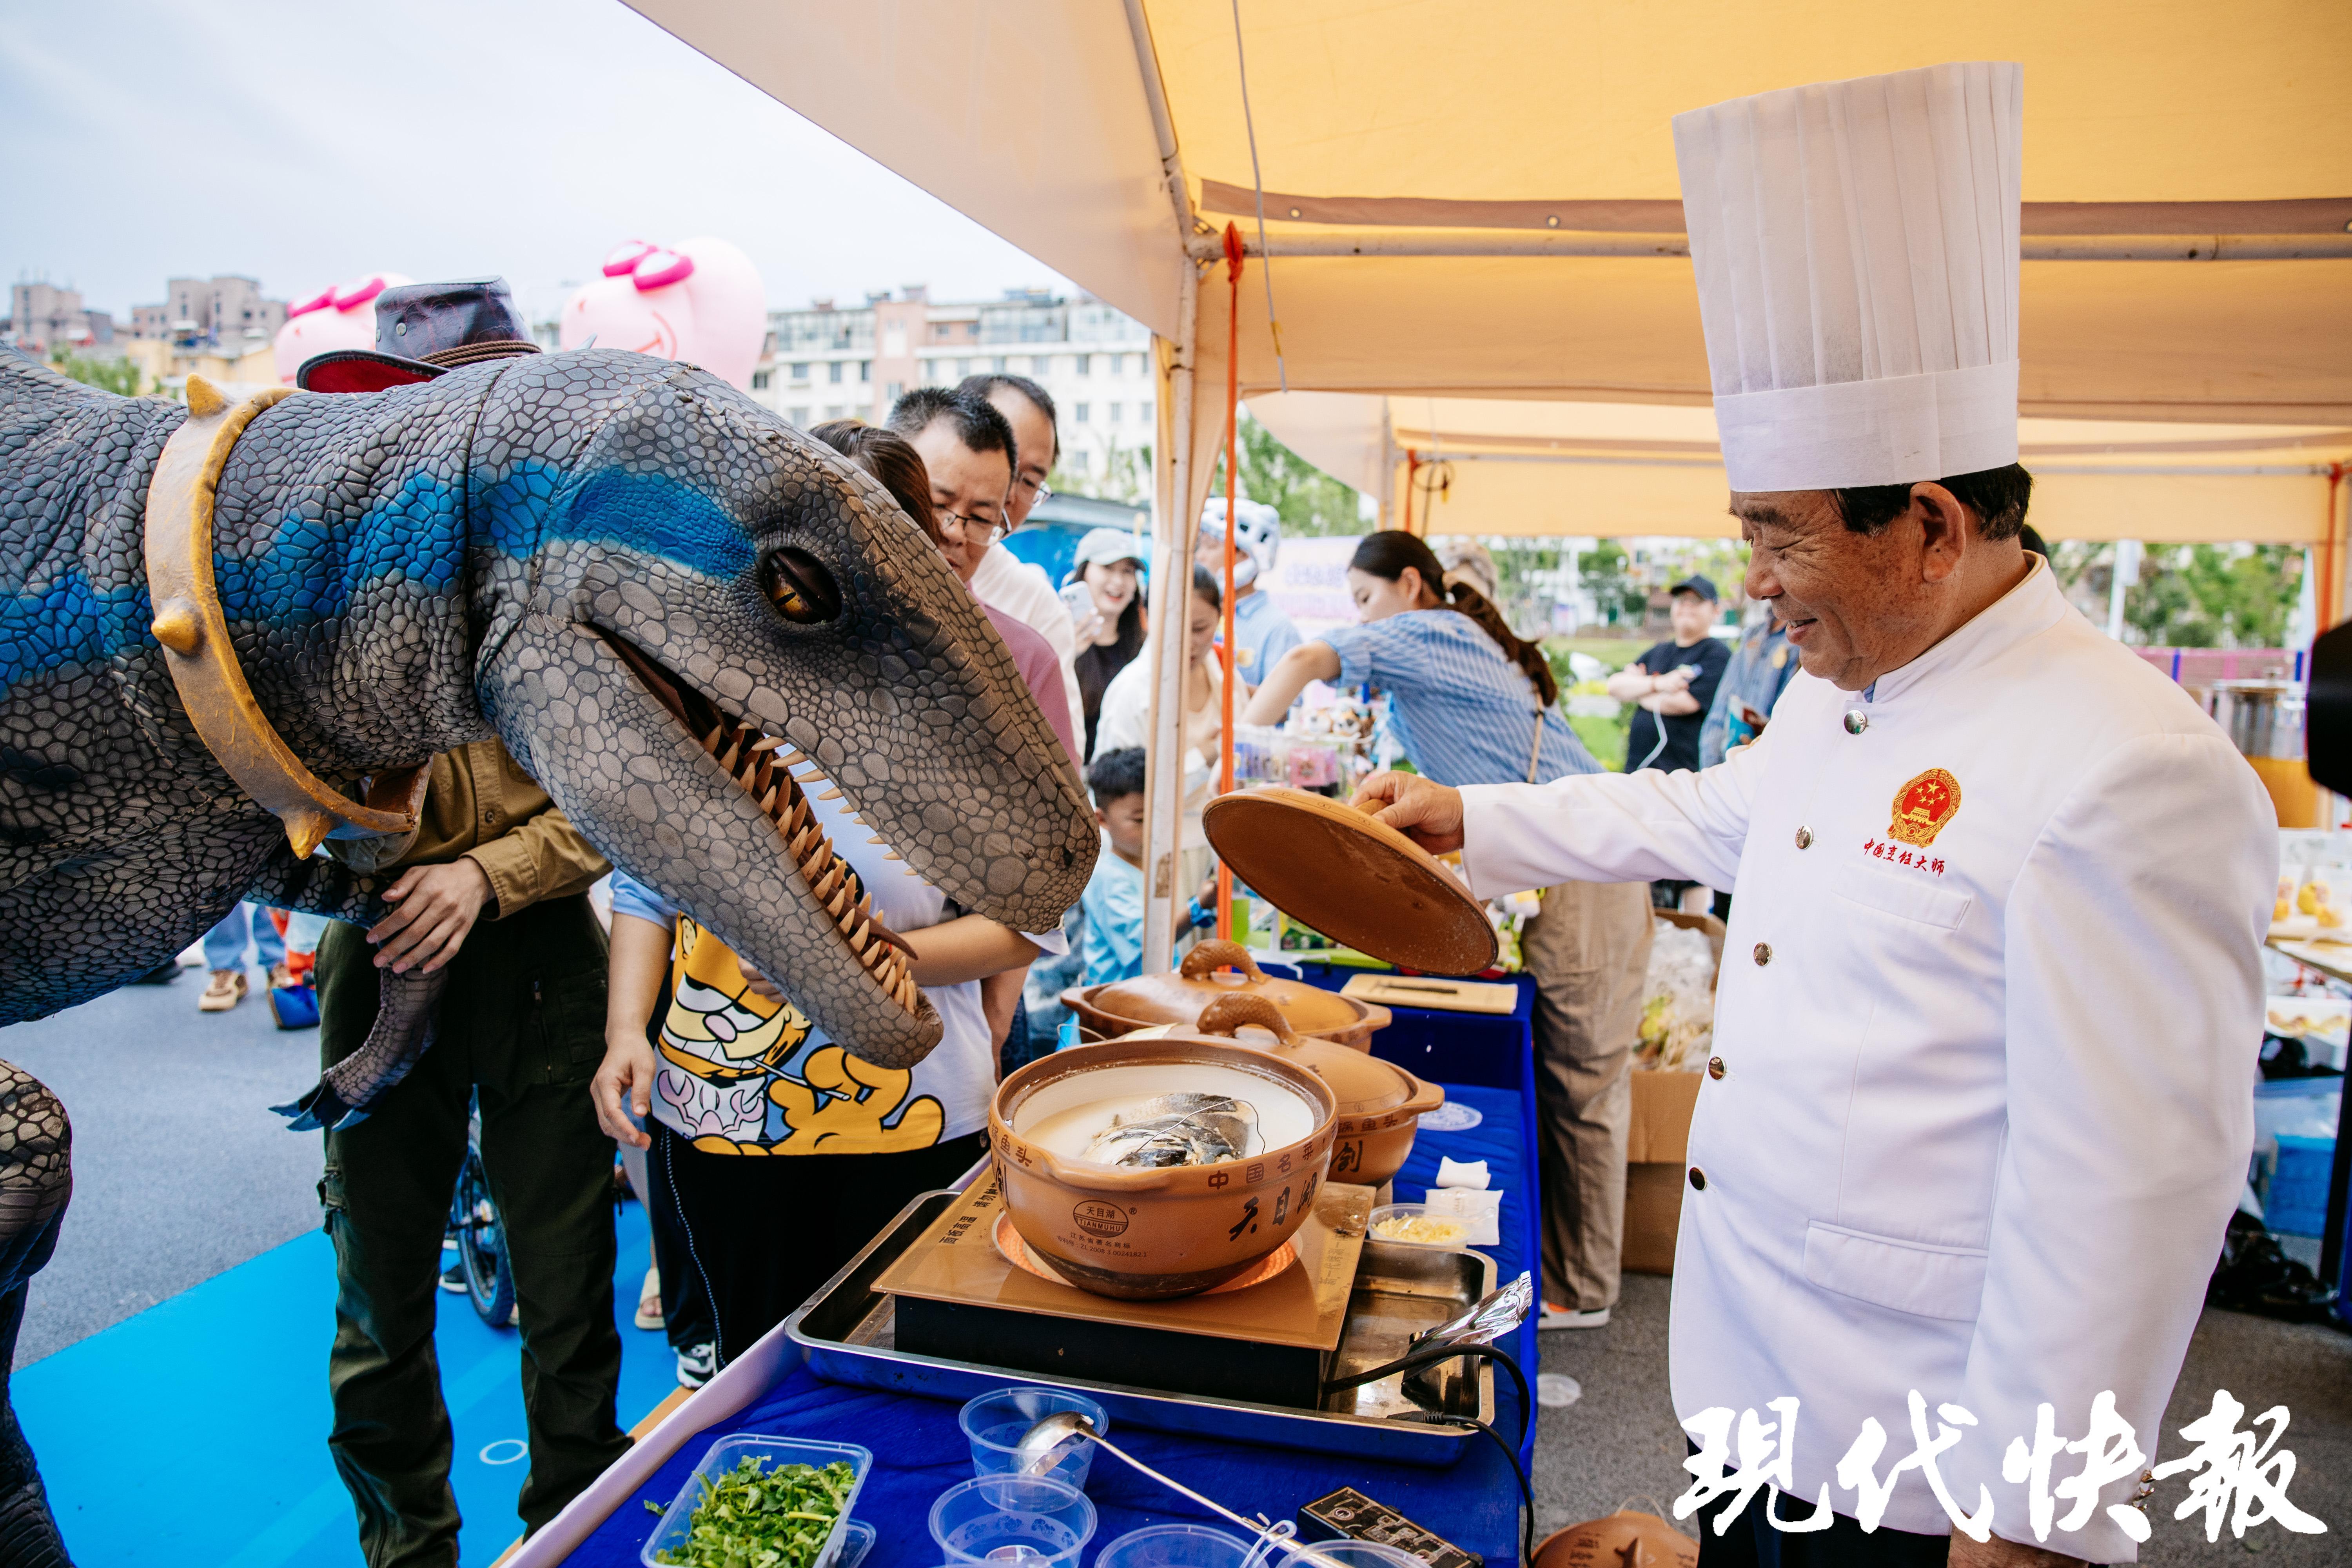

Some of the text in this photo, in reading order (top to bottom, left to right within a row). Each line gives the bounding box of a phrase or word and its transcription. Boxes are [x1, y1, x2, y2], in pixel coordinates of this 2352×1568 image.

[1864, 838, 1945, 878] 中国烹饪大师
[1086, 1206, 1115, 1220] 天目湖
[1229, 1171, 1318, 1242] 天目湖
[1079, 1218, 1121, 1232] TIANMUHU
[1070, 1232, 1131, 1249] 江苏省著名商标
[1089, 1246, 1105, 1254] 2008
